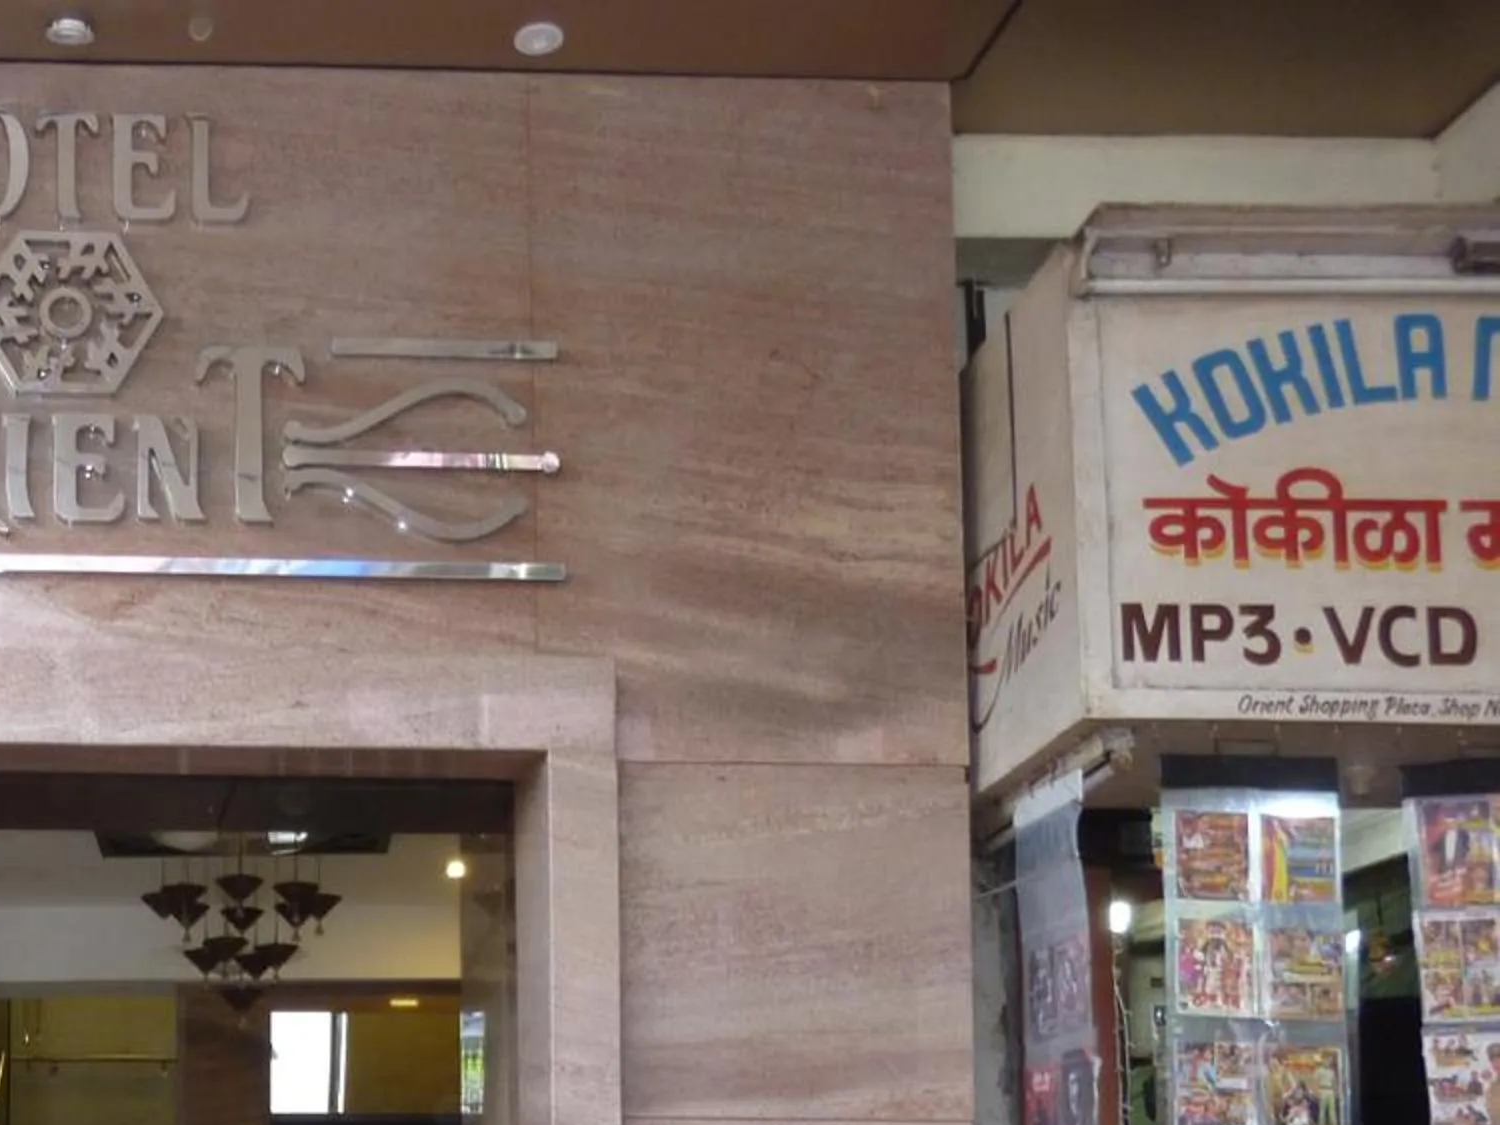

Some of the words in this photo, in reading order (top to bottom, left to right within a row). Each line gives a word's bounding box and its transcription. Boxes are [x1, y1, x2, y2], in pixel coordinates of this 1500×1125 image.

[1132, 314, 1448, 467] KOKILA
[1143, 467, 1448, 572] कोकीळा
[1121, 603, 1282, 666] MP3
[1322, 605, 1478, 667] VCD
[1238, 695, 1294, 715] Orient
[1299, 694, 1379, 720] Shopping
